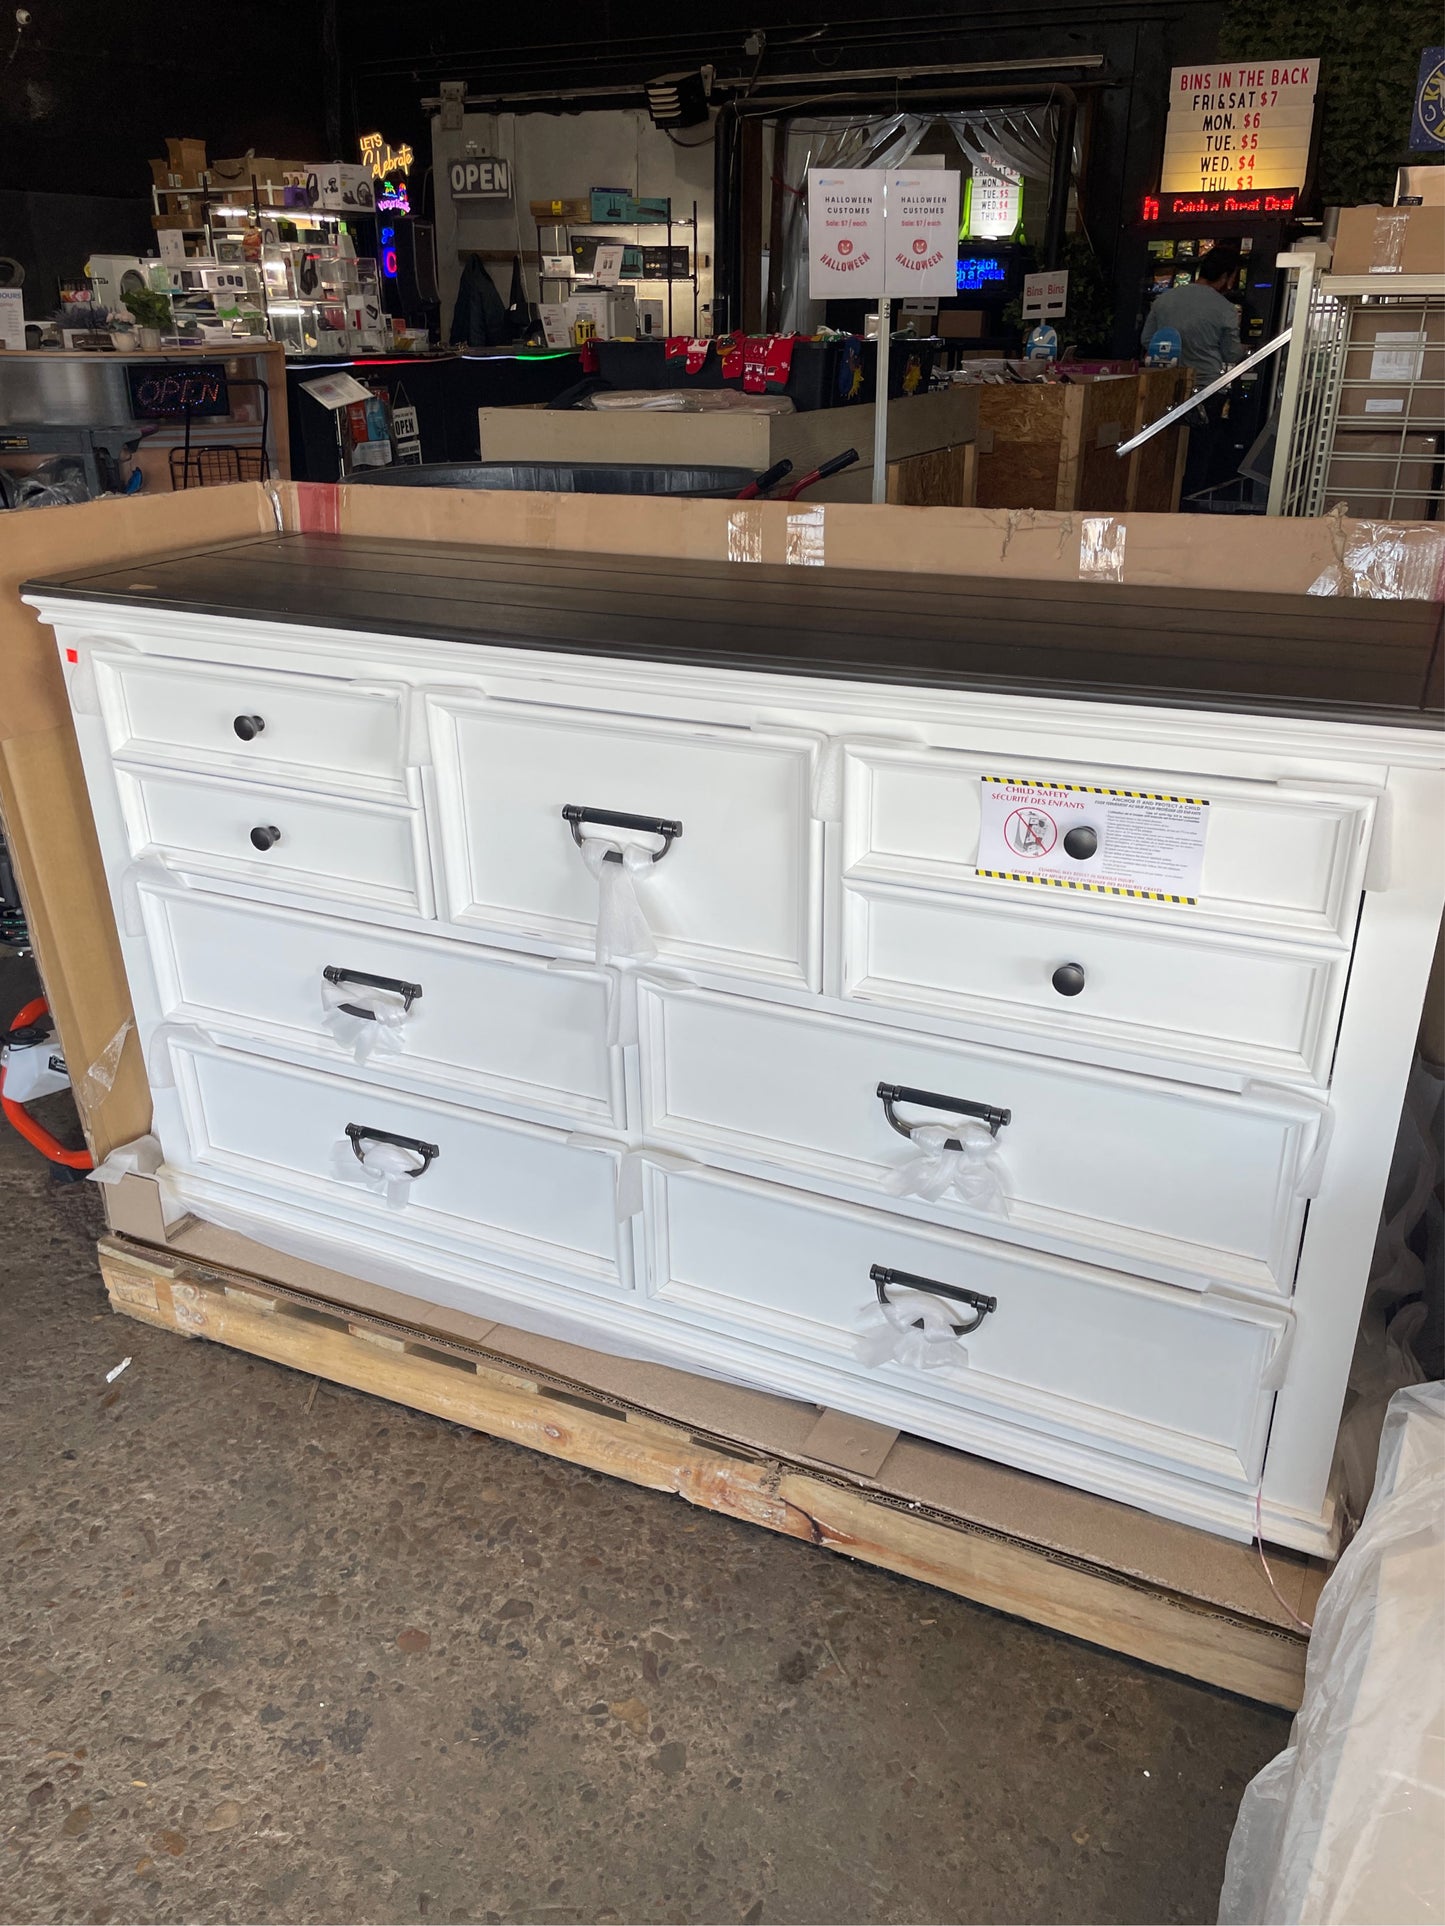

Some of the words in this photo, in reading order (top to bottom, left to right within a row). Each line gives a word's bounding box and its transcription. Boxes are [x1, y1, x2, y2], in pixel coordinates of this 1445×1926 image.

[1180, 73, 1211, 91] BINS
[1218, 71, 1232, 88] IN
[1239, 69, 1265, 87] THE
[1271, 67, 1310, 86] BACK
[1193, 91, 1256, 111] FRI&SAT
[1260, 91, 1278, 107] $7
[1202, 113, 1236, 131] MON.
[1243, 112, 1261, 129] $6
[359, 133, 383, 151] LETS
[1206, 135, 1236, 152] TUE.
[1241, 134, 1258, 150] $5
[362, 144, 413, 179] Celebrate
[1200, 156, 1233, 172] WED.
[1238, 154, 1256, 171] $4
[451, 163, 508, 191] OPEN
[981, 178, 999, 188] MON.
[1237, 175, 1253, 191] $3
[824, 196, 873, 204] HALLOWEEN
[901, 196, 947, 204] HALLOWEEN
[983, 190, 999, 199] TUE.
[1000, 189, 1009, 198] $5
[1264, 194, 1296, 211] Deal
[827, 207, 870, 215] CUSTOMES
[903, 207, 945, 215] CUSTOMES
[981, 201, 999, 210] WED.
[999, 201, 1008, 209] $4
[998, 211, 1008, 220] $3
[820, 252, 871, 272] HALLOWEEN
[895, 251, 944, 271] HALLOWEEN
[977, 270, 1006, 280] Great
[1026, 286, 1044, 297] Bins
[1047, 284, 1065, 295] Bins
[138, 378, 219, 404] OPEN
[394, 418, 415, 436] OPEN
[1005, 785, 1035, 795] CHILD
[1037, 789, 1069, 799] SAFETY
[991, 792, 1029, 804] SÉCURITÉ
[1030, 797, 1046, 805] DES
[1048, 799, 1085, 810] ENFANTS
